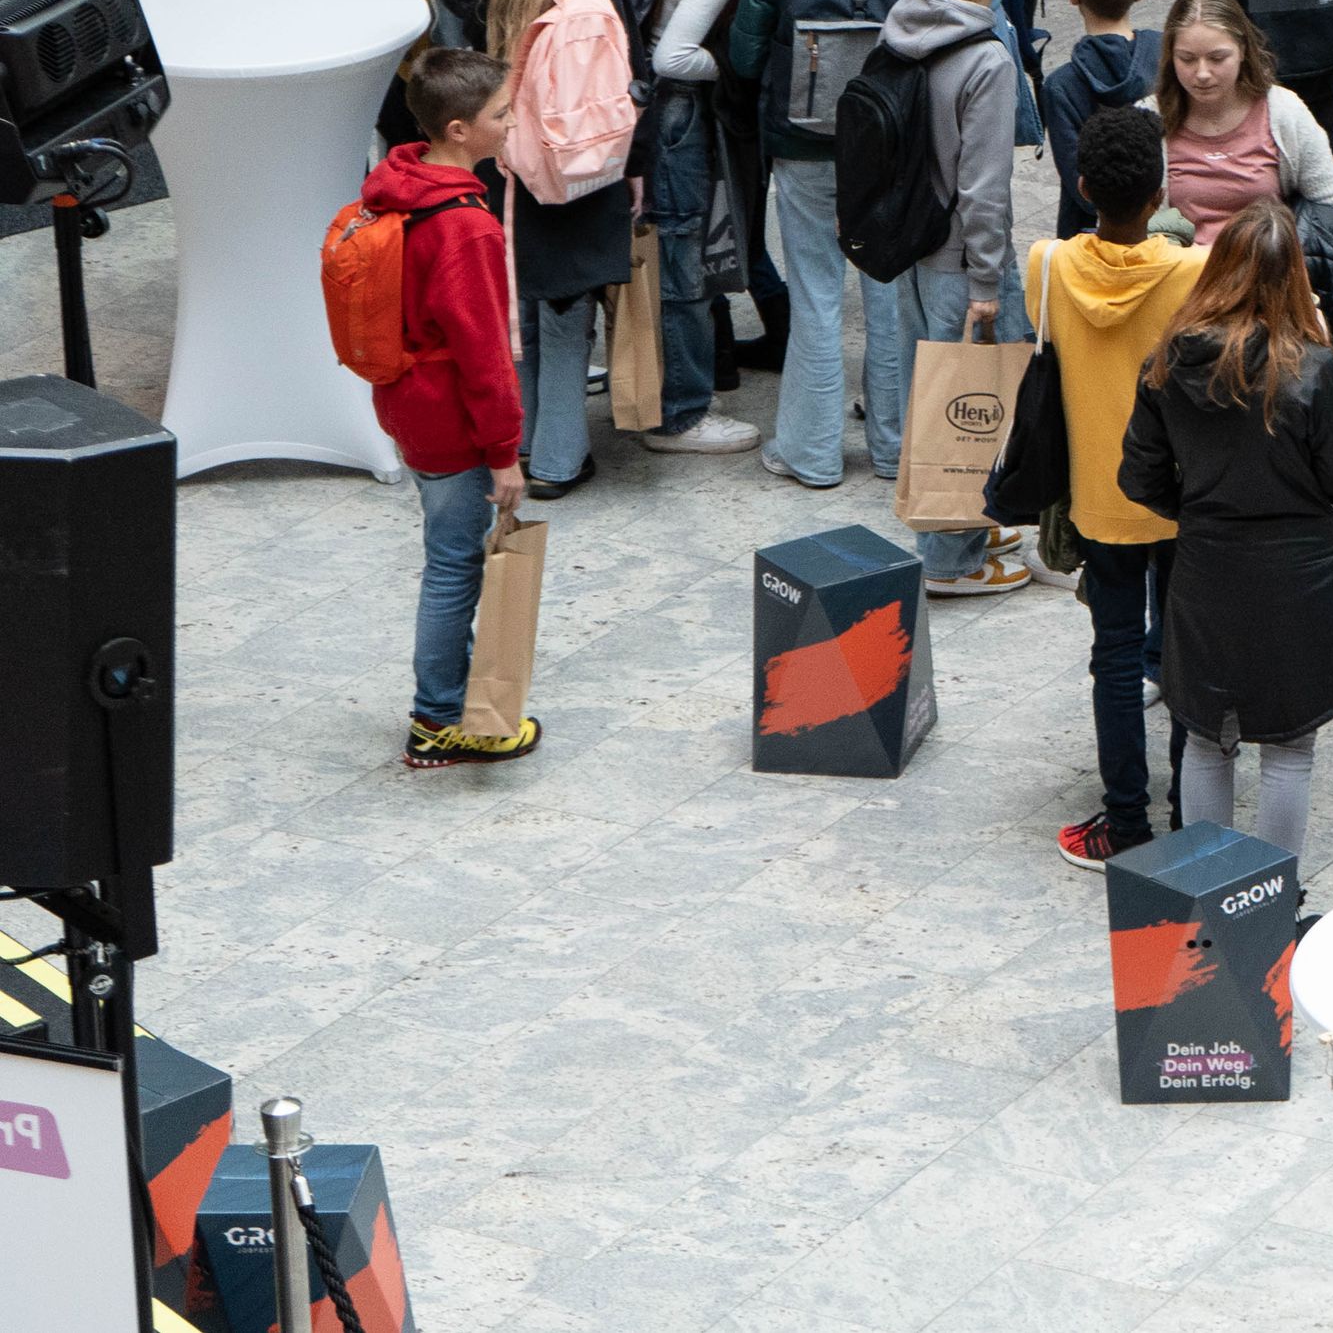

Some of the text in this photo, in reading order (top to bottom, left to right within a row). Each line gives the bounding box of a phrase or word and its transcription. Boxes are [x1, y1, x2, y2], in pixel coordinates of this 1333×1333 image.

[762, 572, 802, 605] GROW
[1220, 875, 1284, 915] GROW
[1167, 1041, 1245, 1056] Dein Job.
[1164, 1058, 1249, 1074] Dein Weg.
[1159, 1074, 1256, 1089] Dein Erfolg.
